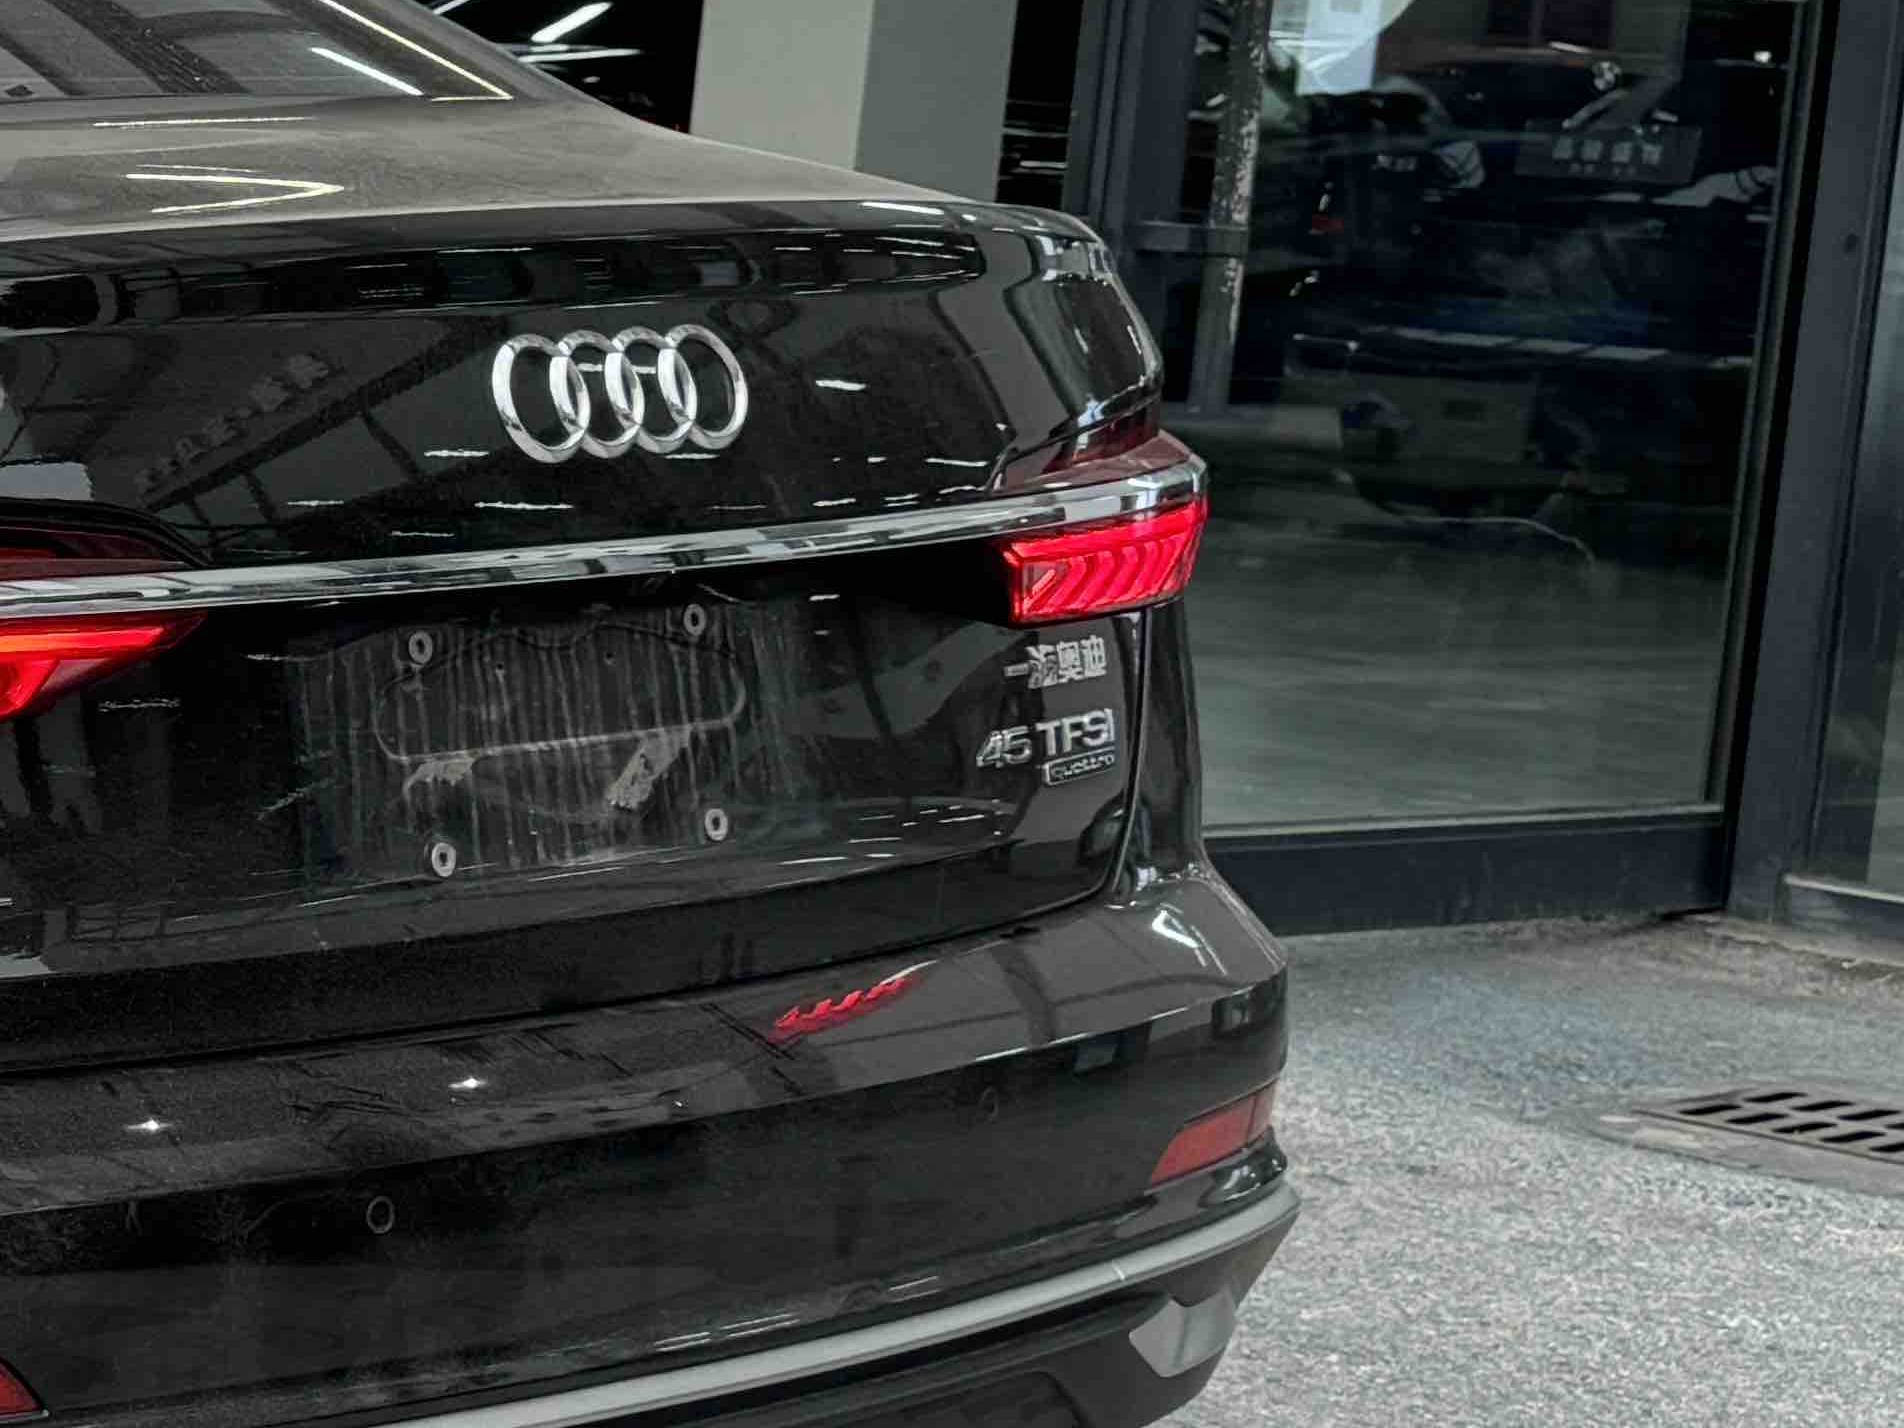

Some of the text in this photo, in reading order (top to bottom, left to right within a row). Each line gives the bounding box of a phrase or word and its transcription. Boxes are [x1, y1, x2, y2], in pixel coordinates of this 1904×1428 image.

[1004, 634, 1108, 689] 一汽奥迪
[976, 707, 1116, 768] 45 TFSI
[1049, 753, 1116, 783] quattro
